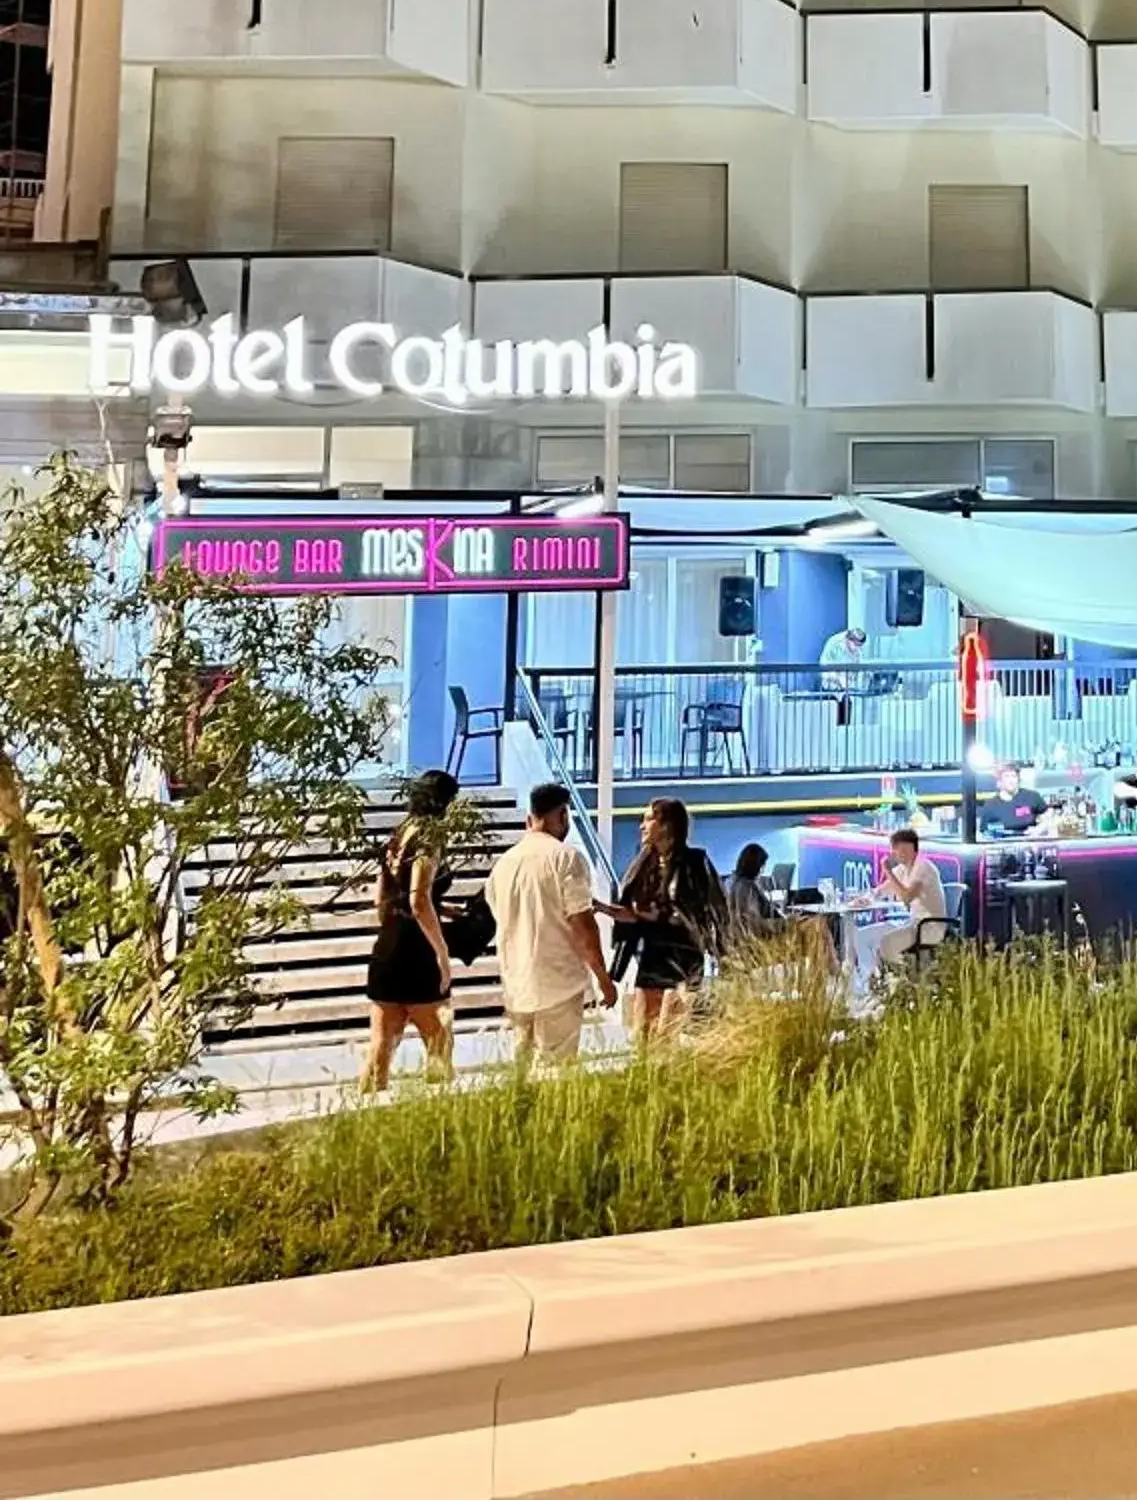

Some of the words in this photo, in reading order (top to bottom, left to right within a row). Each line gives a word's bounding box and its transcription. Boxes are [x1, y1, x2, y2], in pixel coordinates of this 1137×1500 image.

[88, 312, 315, 396] Hotel
[329, 322, 700, 400] Columbia
[294, 539, 344, 574] BAR
[512, 537, 601, 571] RIMINI
